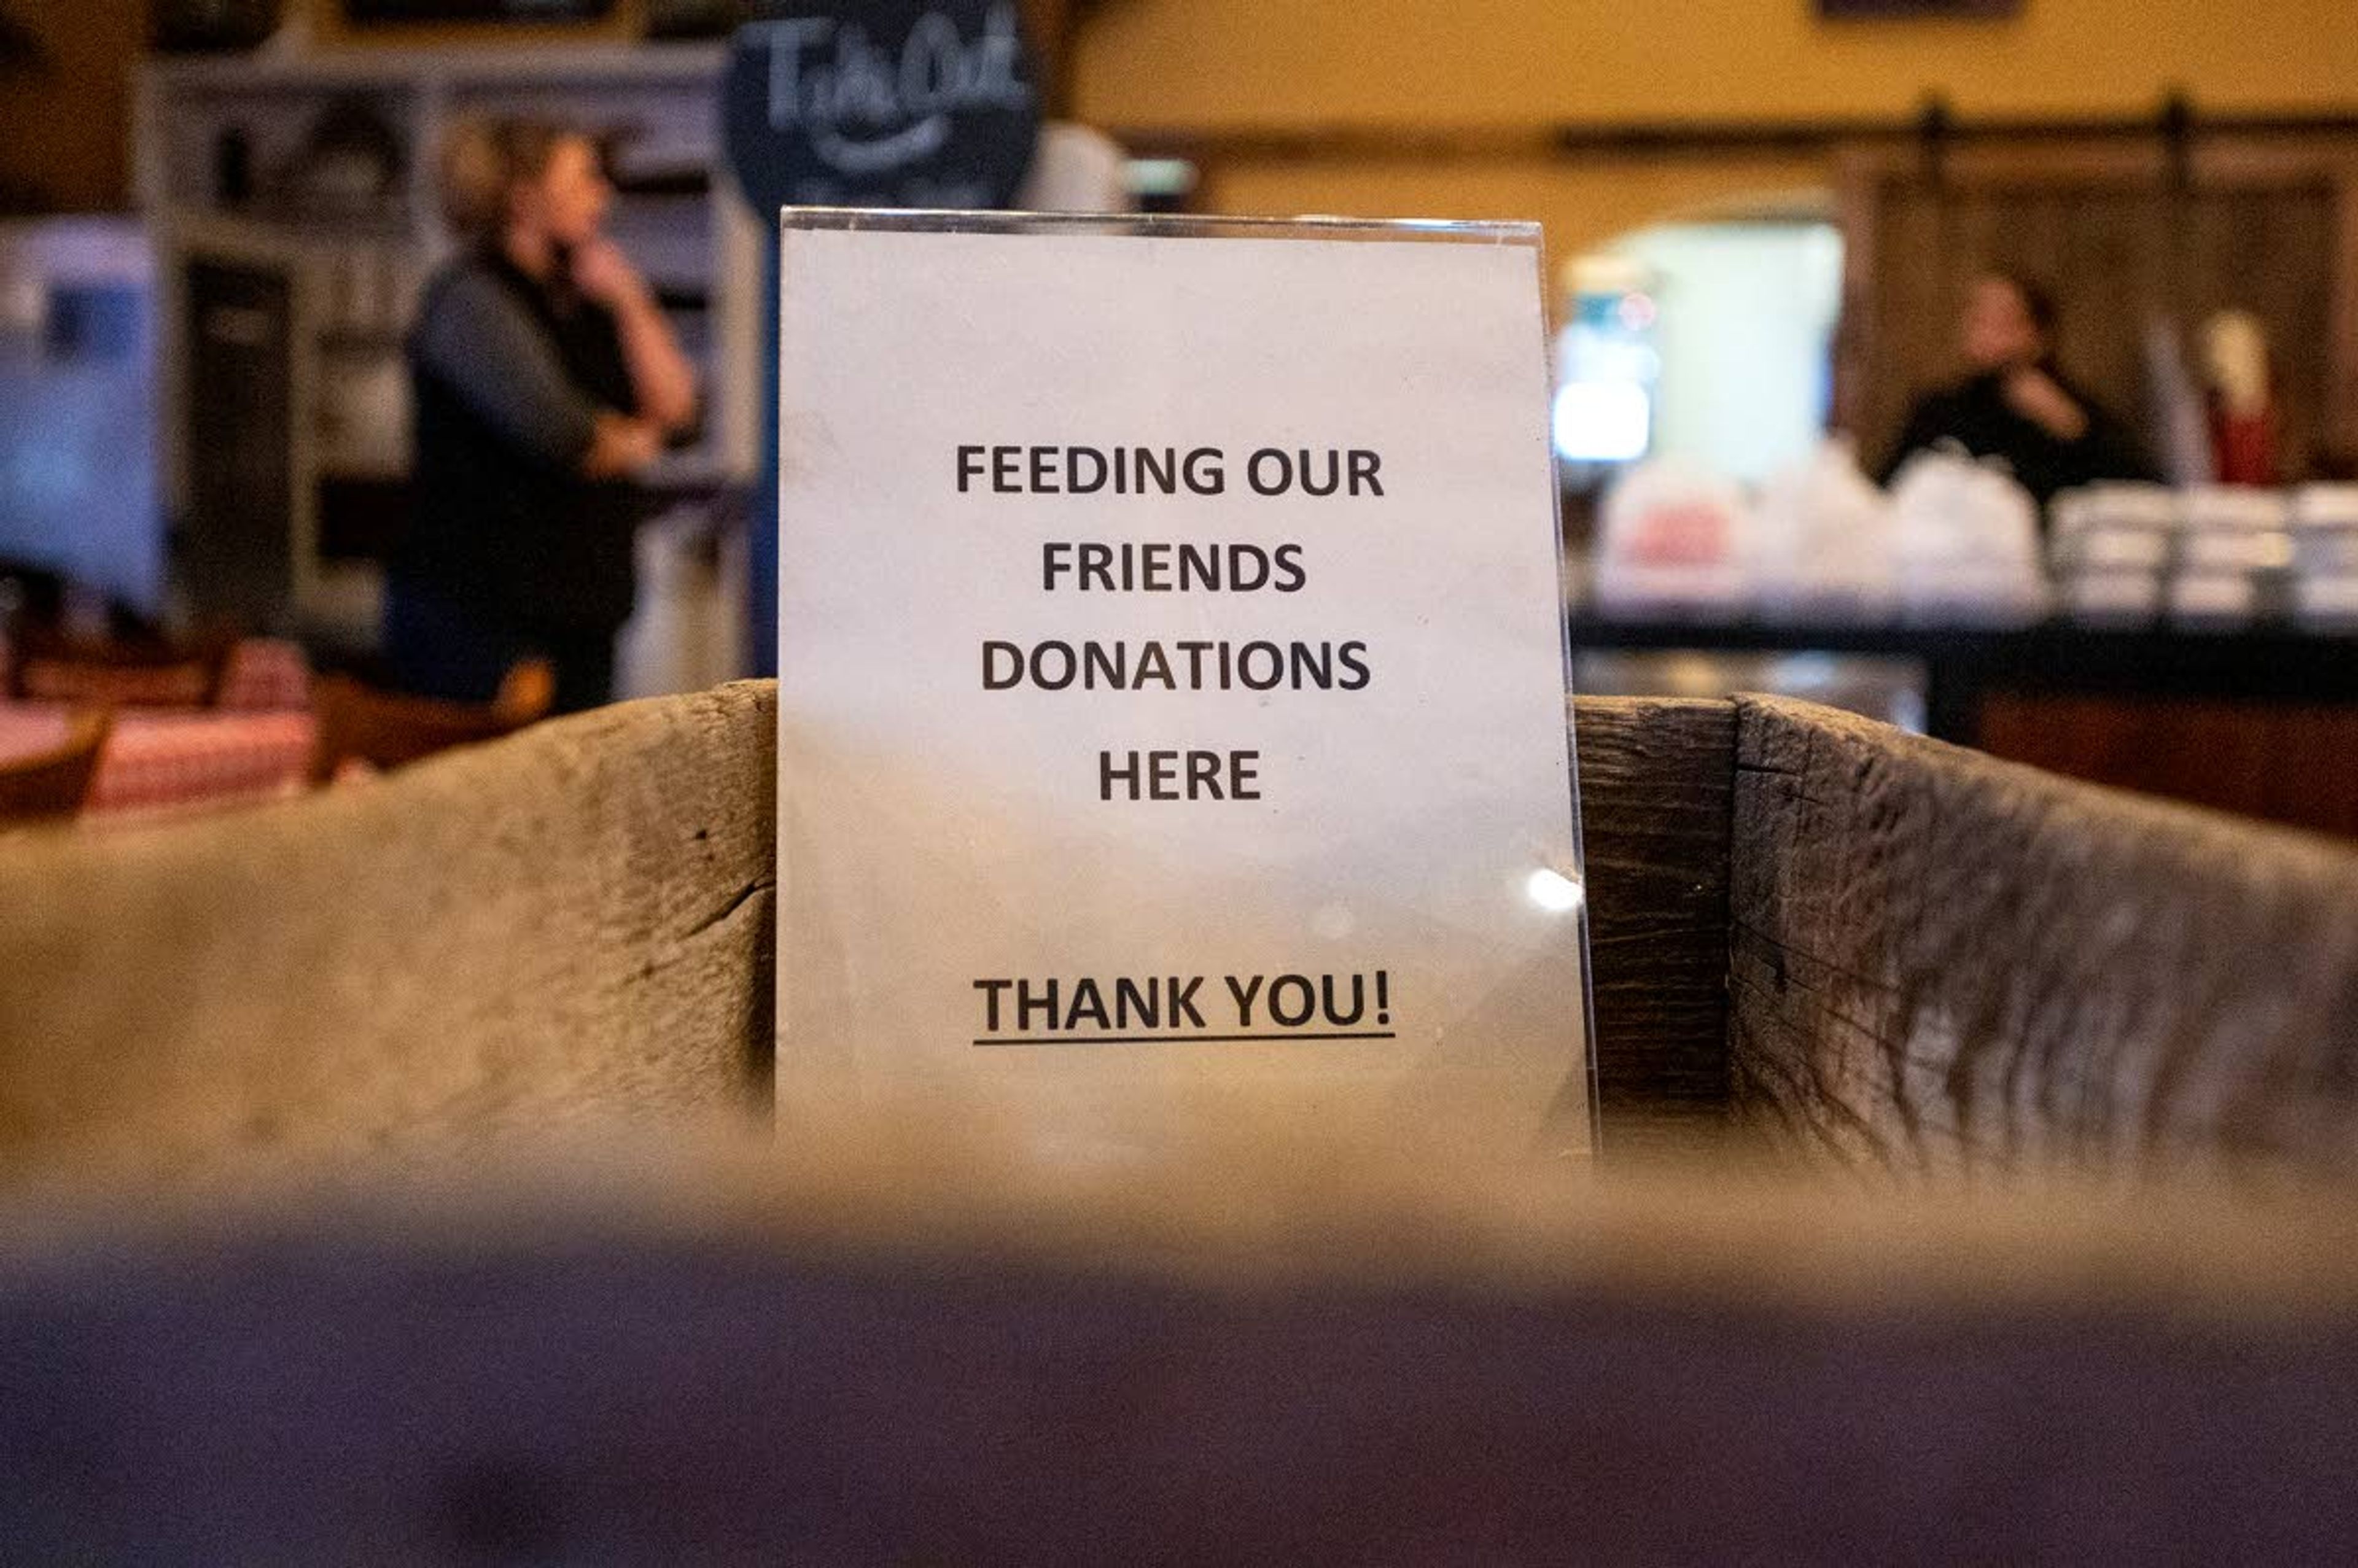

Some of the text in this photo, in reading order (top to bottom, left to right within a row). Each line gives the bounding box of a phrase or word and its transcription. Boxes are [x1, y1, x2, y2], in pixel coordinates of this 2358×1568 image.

[957, 446, 1384, 496] FEEDING OUR
[1043, 543, 1305, 594] FRIENDS
[983, 640, 1370, 690] DONATIONS
[1100, 751, 1260, 800] HERE
[973, 970, 1390, 1031] THANK YOU!
